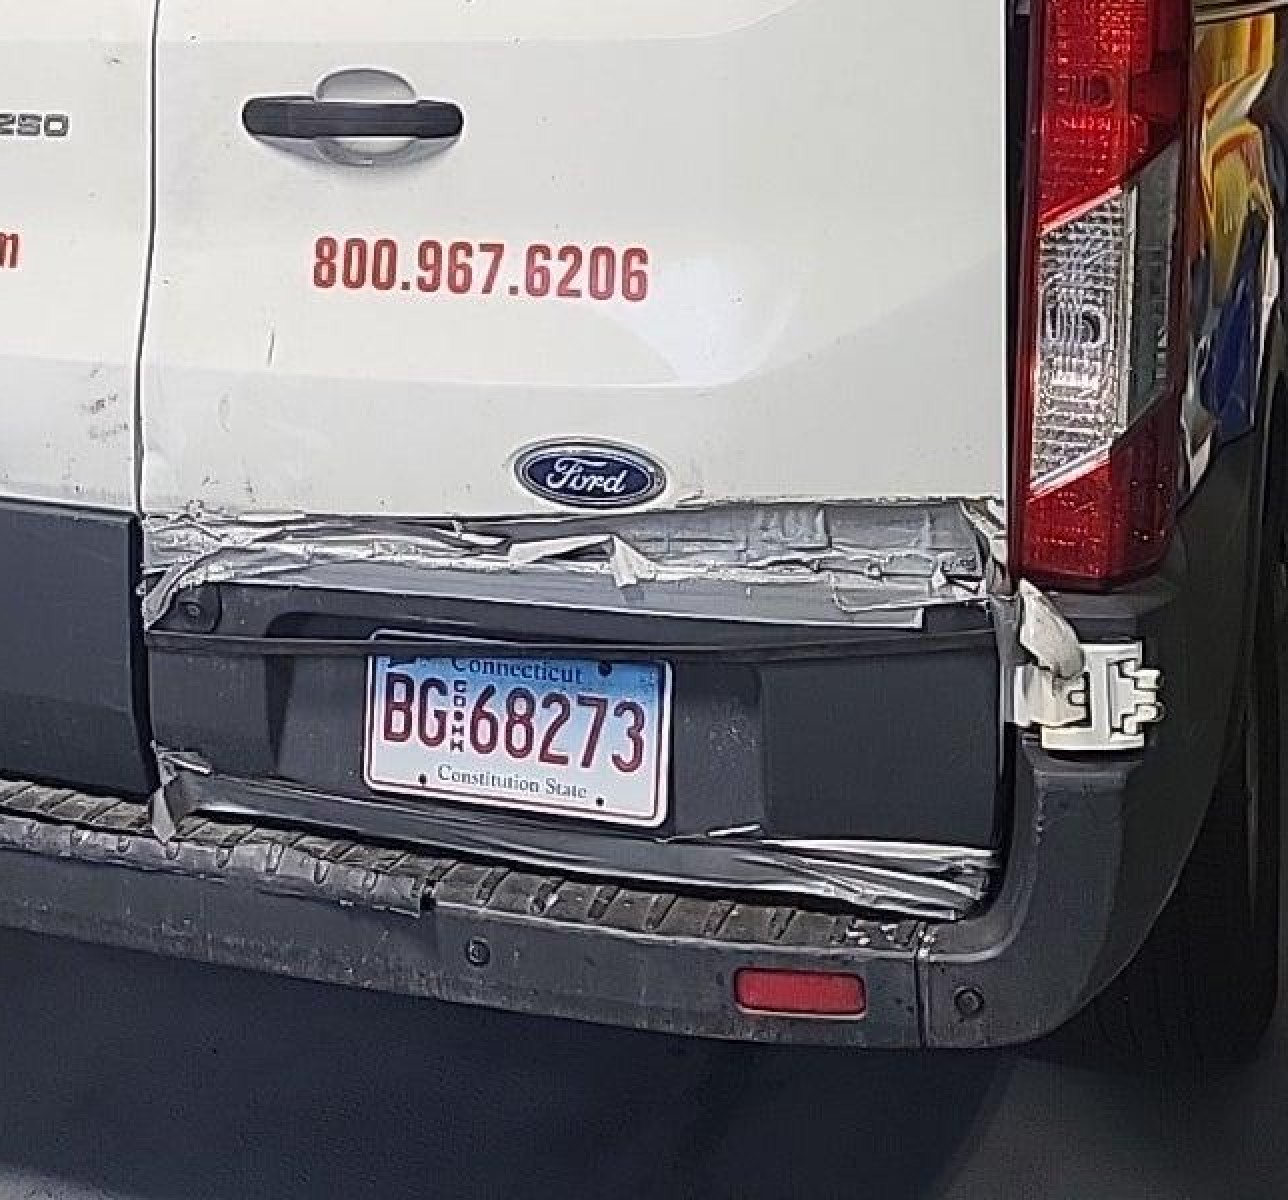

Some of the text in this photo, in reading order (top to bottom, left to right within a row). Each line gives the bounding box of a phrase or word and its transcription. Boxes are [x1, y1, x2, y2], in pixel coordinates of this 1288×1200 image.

[312, 235, 649, 302] 800.967.6206
[545, 457, 629, 497] Ford
[451, 657, 583, 684] Connecticut
[437, 764, 587, 799] Constitution State
